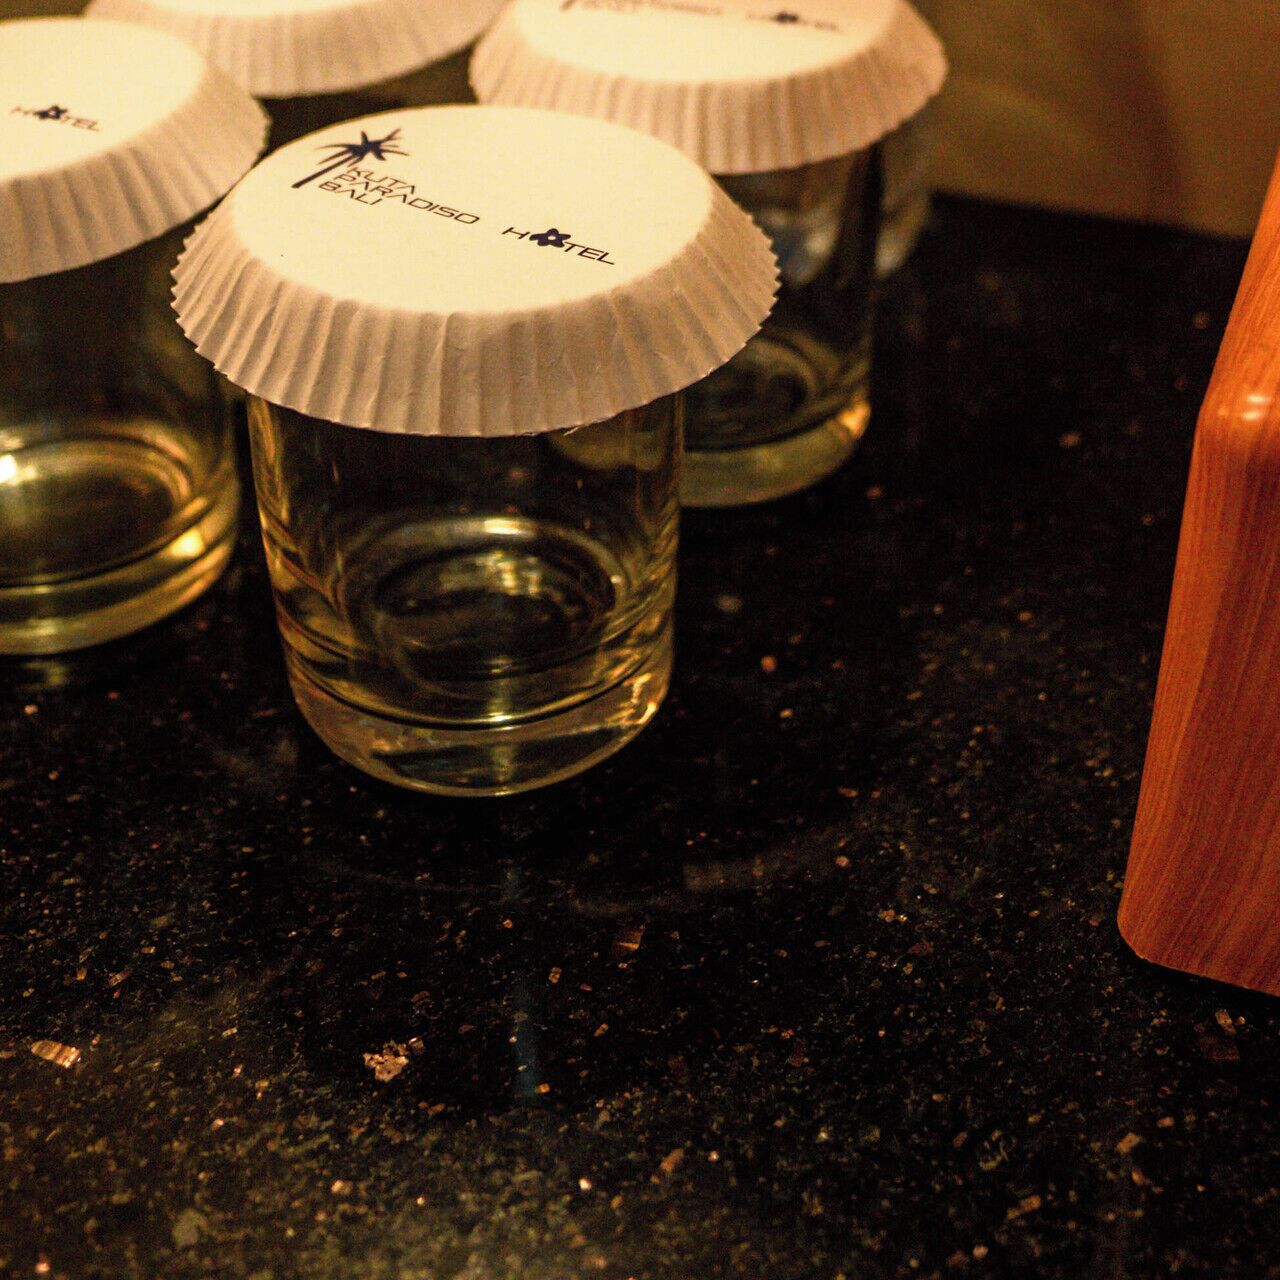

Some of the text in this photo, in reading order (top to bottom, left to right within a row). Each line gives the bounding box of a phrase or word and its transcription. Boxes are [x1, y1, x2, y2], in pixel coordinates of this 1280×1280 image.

[319, 181, 383, 206] BALI
[347, 167, 416, 195] KUTA
[333, 173, 480, 224] PARADISO
